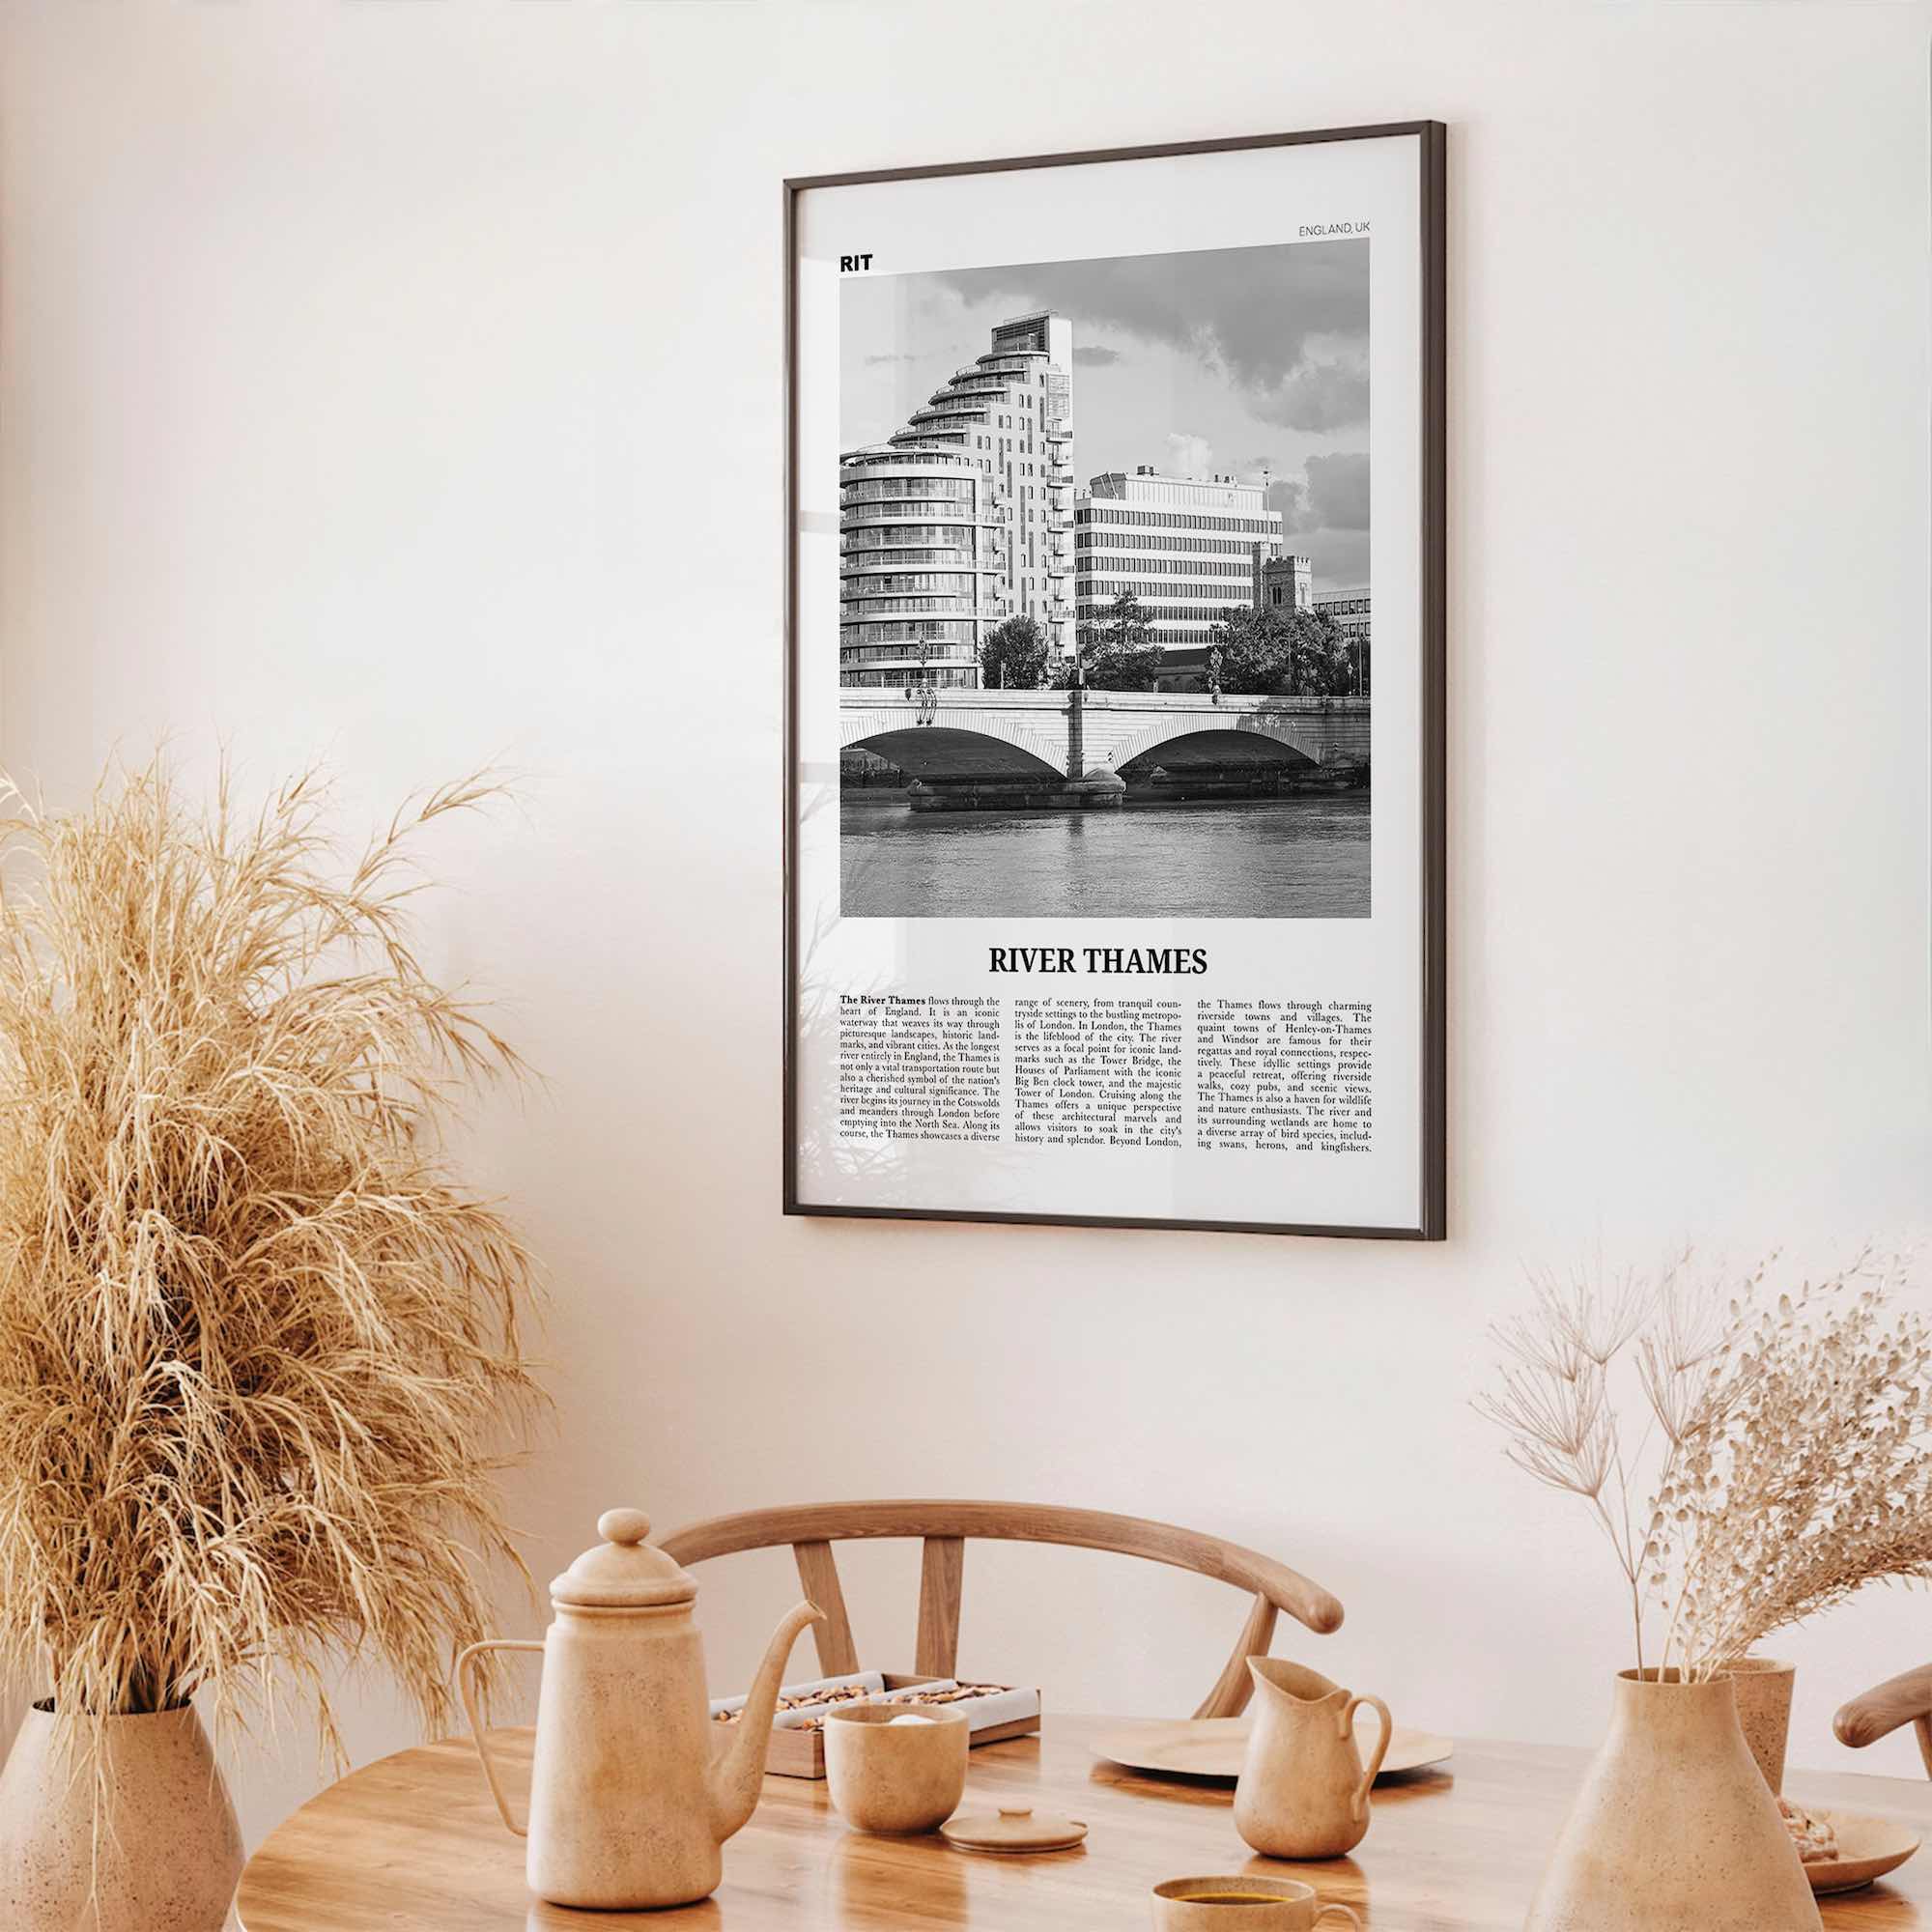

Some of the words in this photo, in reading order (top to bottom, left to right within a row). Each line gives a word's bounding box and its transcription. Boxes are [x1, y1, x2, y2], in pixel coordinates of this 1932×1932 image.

[1299, 222, 1353, 237] ENGLAND,
[1355, 221, 1370, 233] UK
[840, 254, 873, 272] RIT
[988, 948, 1076, 973] RIVER
[1083, 949, 1208, 974] THAMES
[838, 995, 858, 1005] The
[860, 996, 886, 1005] River
[889, 996, 925, 1005] Thames
[927, 996, 950, 1006] flows
[951, 996, 983, 1009] through
[985, 997, 1000, 1006] the
[1013, 1000, 1038, 1009] range
[1041, 998, 1051, 1007] of
[1055, 1000, 1090, 1009] scenery,
[1093, 998, 1114, 1007] from
[1117, 998, 1152, 1009] tranquil
[1196, 1000, 1211, 1009] the
[1217, 1000, 1252, 1009] Thames
[1257, 1001, 1281, 1009] flows
[1286, 1001, 1321, 1012] through
[1327, 1001, 1372, 1013] charming
[838, 1007, 861, 1015] heart
[867, 1007, 876, 1015] of
[884, 1007, 922, 1019] England.
[928, 1008, 935, 1016] It
[974, 1009, 1000, 1017] iconic
[1196, 1011, 1235, 1021] riverside
[1279, 1012, 1296, 1021] and
[1306, 1012, 1342, 1025] villages.
[1353, 1013, 1372, 1022] The
[1013, 1020, 1024, 1029] lis
[1026, 1020, 1036, 1029] of
[1039, 1020, 1074, 1030] London.
[1078, 1020, 1088, 1030] In
[1091, 1021, 1126, 1032] London,
[1129, 1021, 1143, 1030] the
[1148, 1021, 1181, 1031] Thames
[1196, 1024, 1225, 1035] quaint
[1265, 1024, 1276, 1033] of
[1285, 1024, 1373, 1037] Henley-on-Thames
[838, 1030, 886, 1040] picturesque
[890, 1029, 938, 1041] landscapes,
[941, 1030, 973, 1039] historic
[977, 1031, 1000, 1039] land-
[1196, 1035, 1213, 1043] and
[1222, 1035, 1259, 1044] Windsor
[1288, 1036, 1321, 1045] famous
[1328, 1037, 1342, 1045] for
[1350, 1037, 1373, 1045] their
[838, 1039, 867, 1050] marks,
[867, 1040, 884, 1049] and
[885, 1040, 915, 1050] vibrant
[916, 1041, 940, 1050] cities.
[942, 1041, 953, 1050] As
[954, 1041, 968, 1050] the
[970, 1041, 1001, 1053] longest
[860, 1051, 892, 1063] entirely
[893, 1052, 903, 1061] in
[903, 1052, 941, 1064] England,
[942, 1052, 956, 1062] the
[958, 1053, 991, 1062] Thames
[1012, 1054, 1039, 1064] marks
[1043, 1055, 1063, 1064] such
[1081, 1055, 1094, 1064] the
[1101, 1055, 1127, 1065] Tower
[1131, 1056, 1162, 1067] Bridge,
[1167, 1056, 1182, 1065] the
[1012, 1065, 1045, 1075] Houses
[1048, 1065, 1058, 1075] of
[1064, 1066, 1109, 1075] Parliament
[1113, 1066, 1133, 1076] with
[1137, 1067, 1151, 1076] the
[1196, 1058, 1222, 1069] tively.
[1231, 1058, 1256, 1067] These
[1263, 1059, 1290, 1070] idyllic
[1296, 1060, 1331, 1071] settings
[1337, 1060, 1372, 1071] provide
[838, 1073, 856, 1082] also
[865, 1073, 904, 1083] cherished
[906, 1074, 936, 1086] symbol
[938, 1074, 948, 1084] of
[951, 1075, 965, 1084] the
[967, 1075, 1000, 1085] nation's
[1208, 1069, 1245, 1081] peaceful
[1251, 1071, 1284, 1081] retreat,
[1290, 1070, 1326, 1083] offering
[1332, 1071, 1374, 1081] riverside
[1013, 1077, 1029, 1089] Big
[1033, 1077, 1048, 1086] Ben
[1052, 1077, 1074, 1087] clock
[1078, 1079, 1104, 1089] tower,
[1107, 1078, 1124, 1088] and
[1127, 1078, 1142, 1088] the
[1146, 1080, 1181, 1091] majestic
[1196, 1081, 1224, 1092] walks,
[1229, 1084, 1250, 1094] cozy
[1256, 1082, 1280, 1094] pubs,
[1286, 1082, 1304, 1092] and
[1344, 1084, 1374, 1093] views.
[838, 1084, 872, 1096] heritage
[875, 1085, 891, 1094] and
[894, 1085, 926, 1094] cultural
[927, 1086, 981, 1098] significance.
[983, 1087, 1002, 1095] The
[1012, 1088, 1041, 1097] Tower
[1044, 1089, 1054, 1097] of
[1059, 1089, 1094, 1098] London.
[1098, 1090, 1136, 1101] Cruising
[1139, 1091, 1164, 1102] along
[1167, 1091, 1181, 1099] the
[838, 1106, 855, 1116] and
[858, 1107, 897, 1117] meanders
[900, 1107, 933, 1120] through
[937, 1108, 970, 1118] London
[973, 1109, 1002, 1119] before
[1012, 1099, 1048, 1109] Thames
[1054, 1100, 1079, 1110] offers
[1096, 1101, 1126, 1113] unique
[1132, 1102, 1181, 1114] perspective
[1196, 1104, 1213, 1113] and
[1217, 1105, 1246, 1114] nature
[1250, 1105, 1301, 1115] enthusiasts.
[1307, 1106, 1324, 1115] The
[1328, 1107, 1350, 1116] river
[1353, 1107, 1374, 1116] and
[1014, 1134, 1043, 1146] history
[1046, 1134, 1064, 1144] and
[1066, 1135, 1105, 1147] splendor.
[1109, 1136, 1141, 1148] Beyond
[1145, 1136, 1181, 1148] London,
[1196, 1139, 1211, 1151] ing
[1218, 1141, 1247, 1150] swans,
[1255, 1140, 1288, 1151] herons,
[1295, 1141, 1313, 1150] and
[1321, 1141, 1374, 1153] kingfishers.
